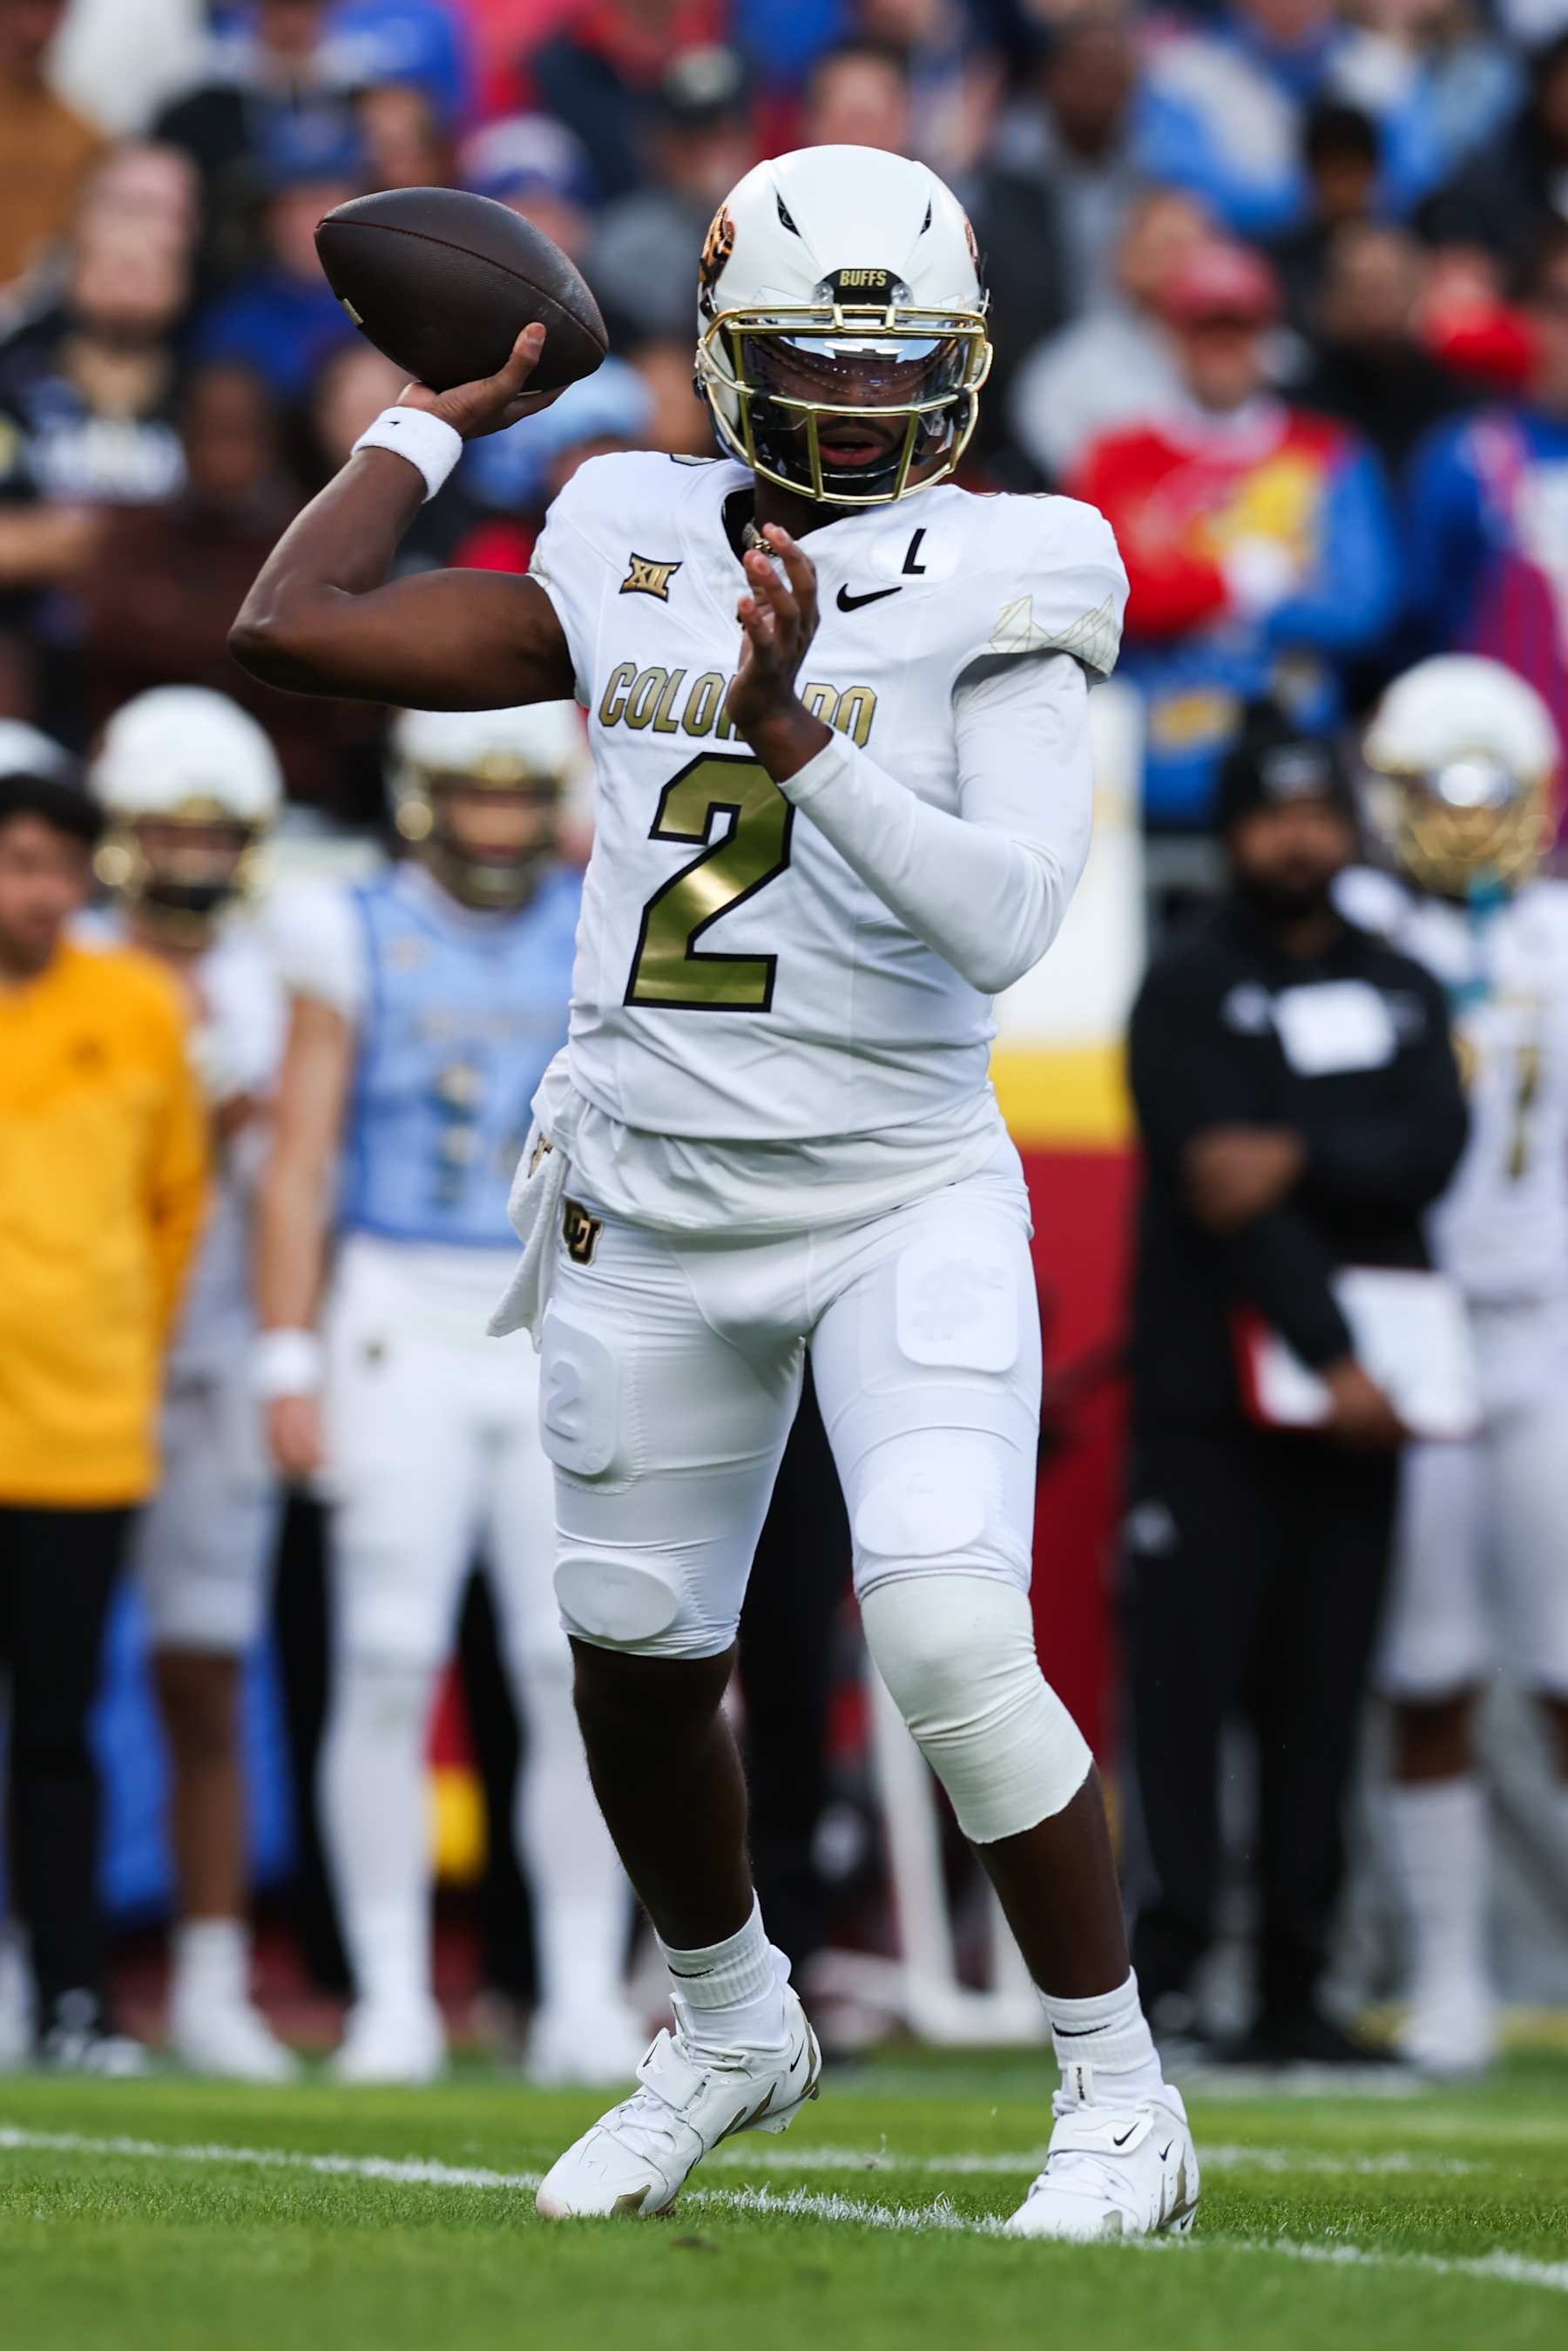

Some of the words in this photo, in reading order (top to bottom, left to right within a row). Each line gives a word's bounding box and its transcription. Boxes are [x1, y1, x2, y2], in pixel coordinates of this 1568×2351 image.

[839, 270, 887, 287] BUFFS
[902, 528, 927, 574] L
[598, 662, 877, 749] COLODO
[623, 752, 794, 1013] 2
